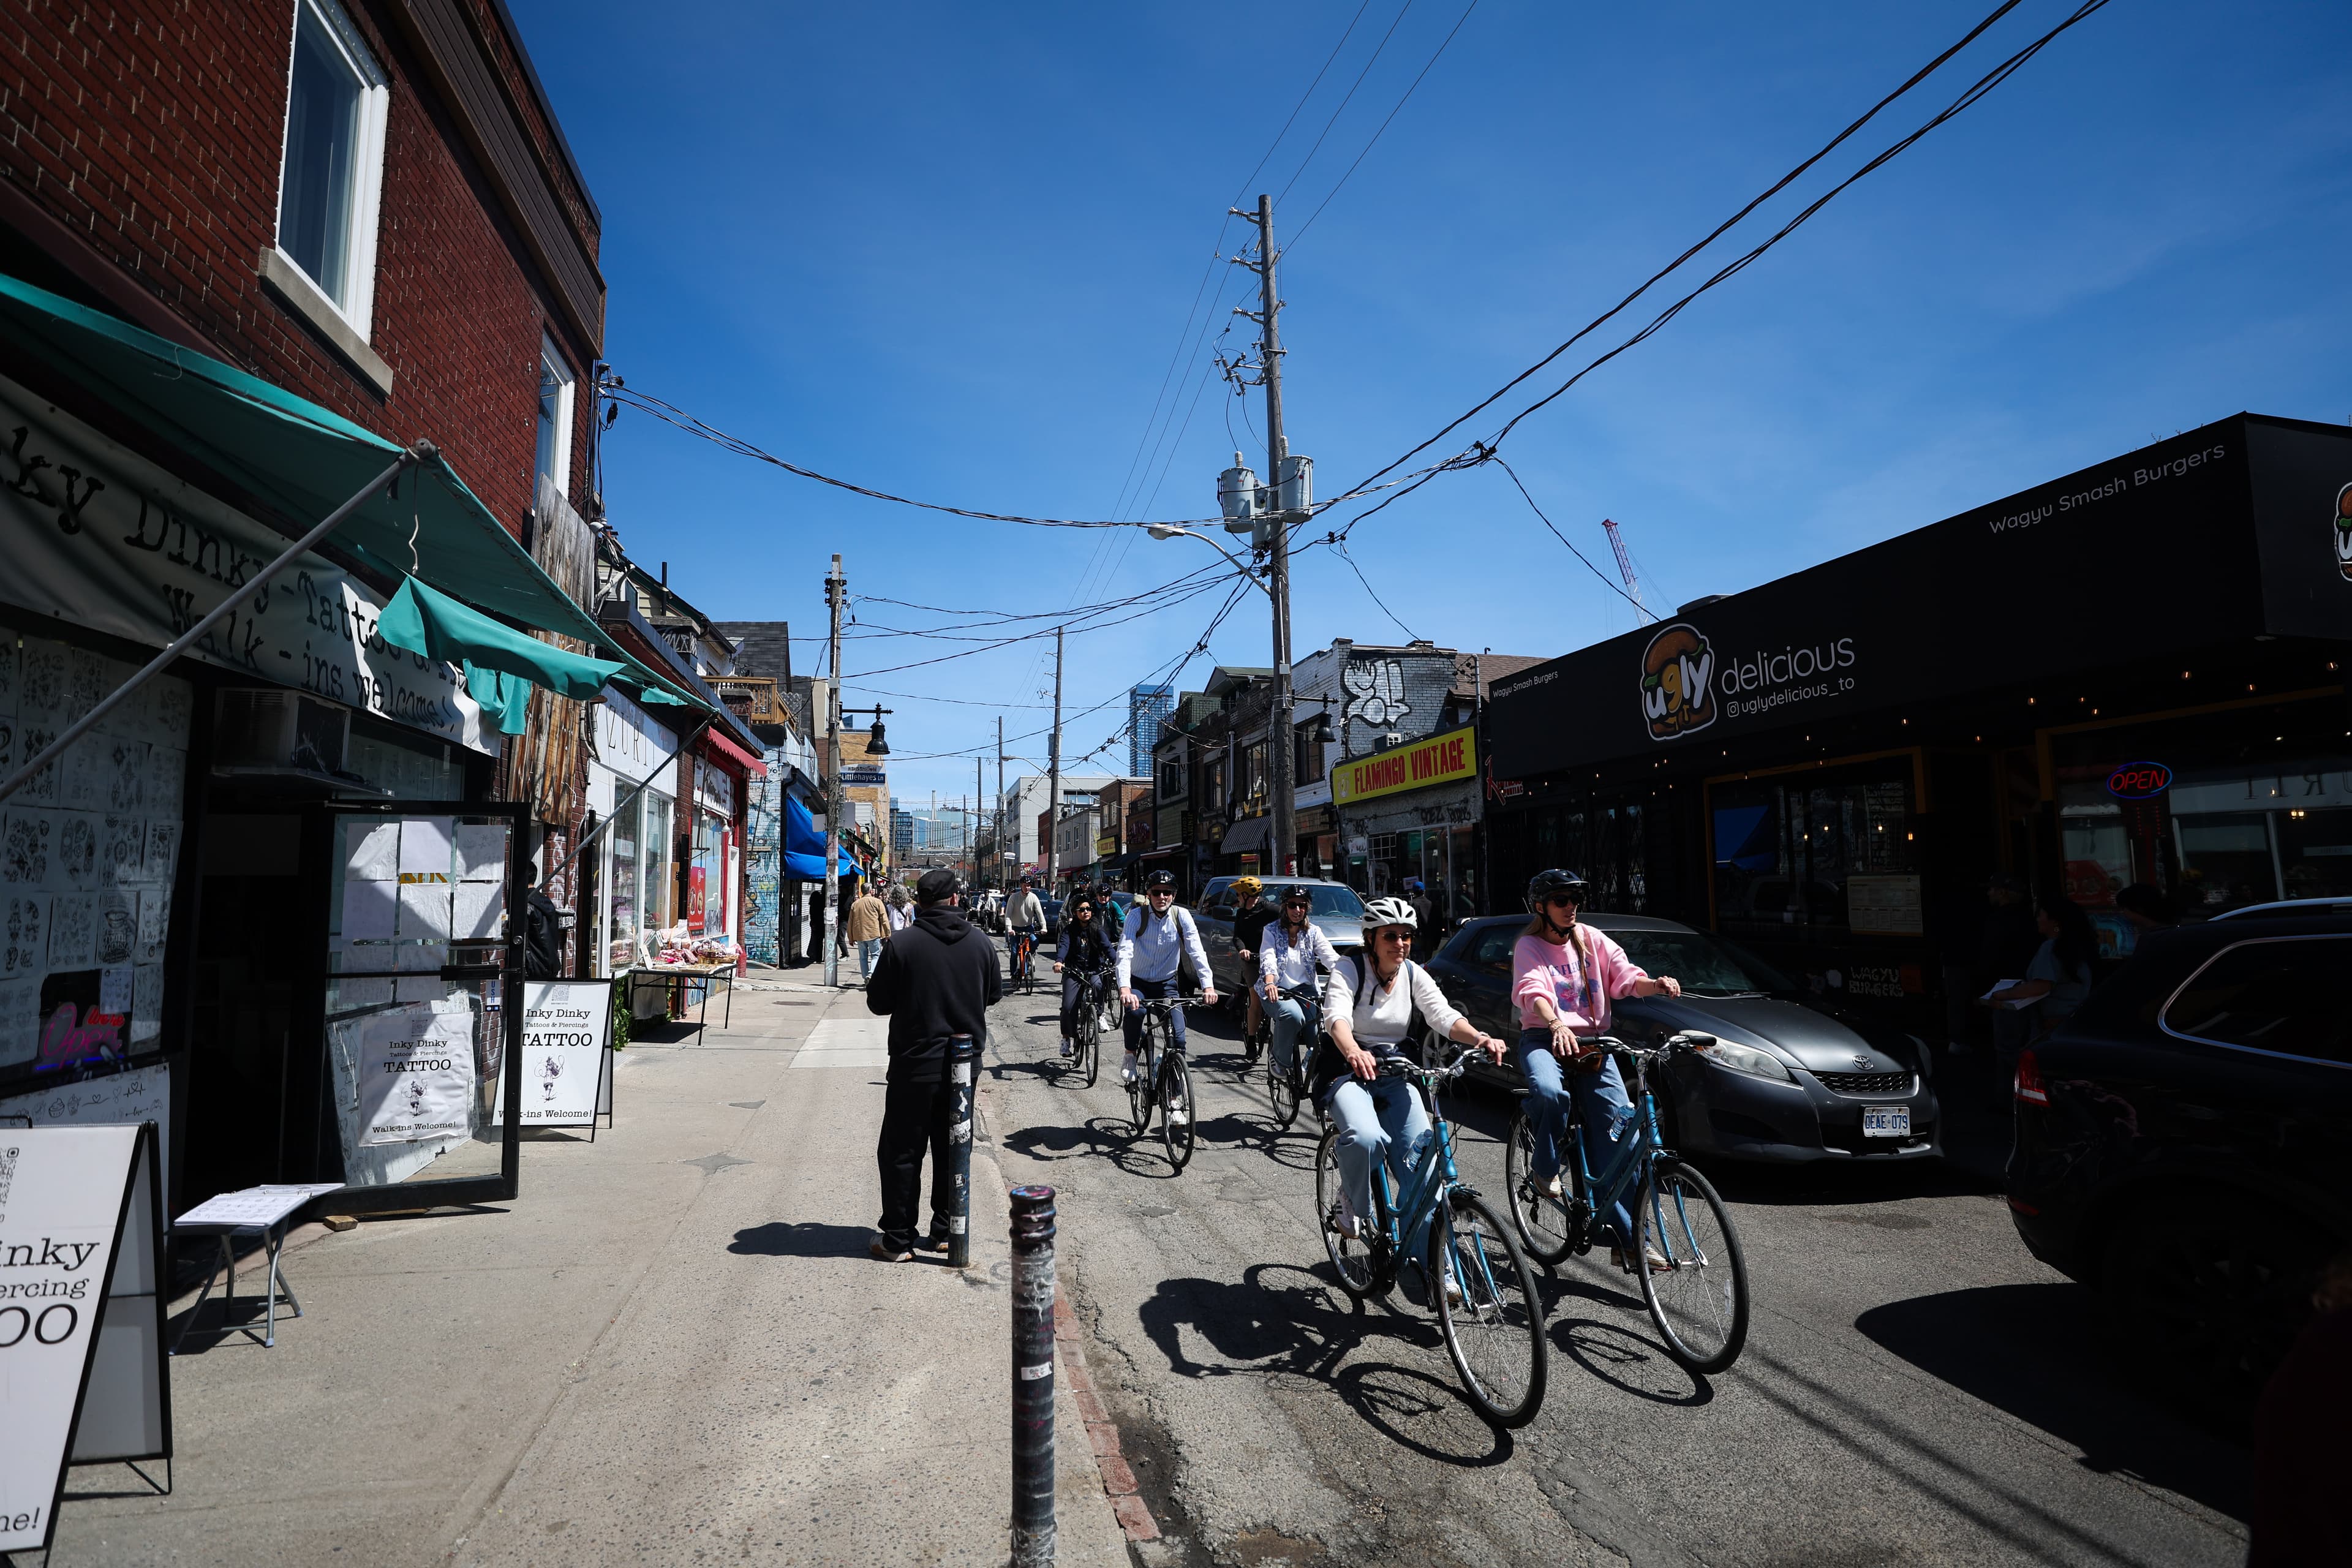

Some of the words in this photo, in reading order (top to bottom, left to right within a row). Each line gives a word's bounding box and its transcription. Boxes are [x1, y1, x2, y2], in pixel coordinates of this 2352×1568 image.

[1989, 503, 2053, 534] Wagyu
[2059, 478, 2127, 512] Smash
[2133, 443, 2226, 488] Burgers
[1721, 638, 1856, 695] delicious
[1493, 686, 1512, 698] Wagyu
[1513, 677, 1532, 692] Smash
[1534, 671, 1558, 685] Burgers
[1646, 654, 1711, 719] ugly
[1354, 755, 1405, 794] FLAMINGO
[1411, 737, 1466, 780] VINTAGE
[842, 773, 876, 782] Littlehayes
[2110, 769, 2165, 792] OPEN
[1850, 966, 1899, 982] WAGYU
[1849, 980, 1905, 997] BURGERS
[526, 1009, 553, 1019] Inky
[556, 1009, 591, 1019] Dinky
[389, 1041, 414, 1049] Inky
[417, 1039, 448, 1048] Dinky
[522, 1033, 592, 1046] TATTOO
[383, 1059, 451, 1073] TATTOO
[545, 1109, 592, 1118] Welcome!
[414, 1121, 456, 1130] Welcome!
